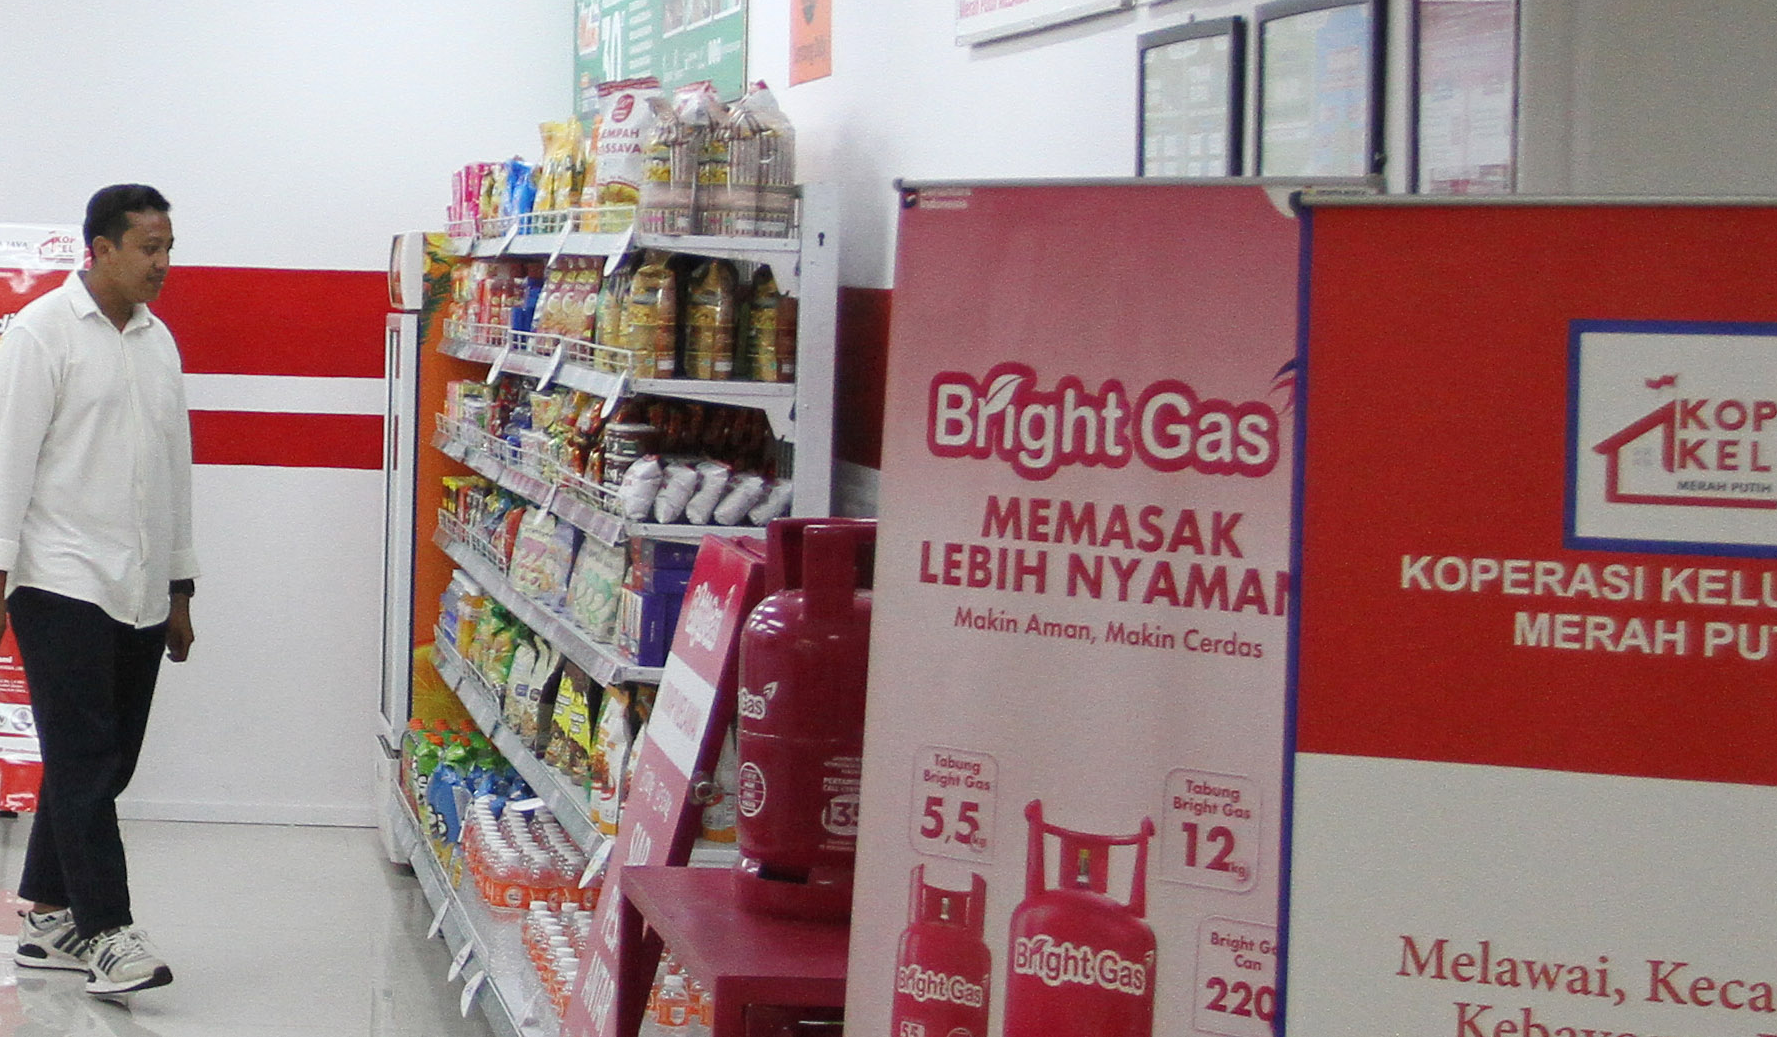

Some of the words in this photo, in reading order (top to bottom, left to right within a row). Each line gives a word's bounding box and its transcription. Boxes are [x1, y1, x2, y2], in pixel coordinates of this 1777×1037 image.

[935, 373, 1123, 469] Bright
[1141, 391, 1271, 466] Gas
[1679, 398, 1777, 433] KOP
[1678, 438, 1772, 473] KEL
[1677, 479, 1726, 493] MERAH
[1731, 480, 1773, 495] PUTIH
[981, 494, 1244, 559] MEMASAK
[919, 540, 1048, 595] LEBIH
[1400, 554, 1645, 601] KOPERASI
[954, 605, 1018, 634] Makin
[1025, 613, 1097, 645] Aman,
[1104, 620, 1176, 650] Makin
[1183, 628, 1264, 659] Cerdas
[1514, 611, 1686, 655] MERAH
[923, 770, 961, 788] Bright
[964, 775, 990, 792] Gas
[934, 753, 981, 774] Tabung
[1172, 796, 1220, 816] Bright
[1224, 802, 1251, 821] Gas
[1185, 778, 1241, 803] Tabung
[919, 795, 980, 846] 5,5
[1182, 821, 1235, 872] 12
[1211, 931, 1255, 952] Bright
[1014, 933, 1092, 983] Bright
[1096, 950, 1146, 996] Gas
[1234, 954, 1263, 972] Can
[1396, 934, 1627, 1006] Melawai,
[949, 975, 983, 1007] Gas
